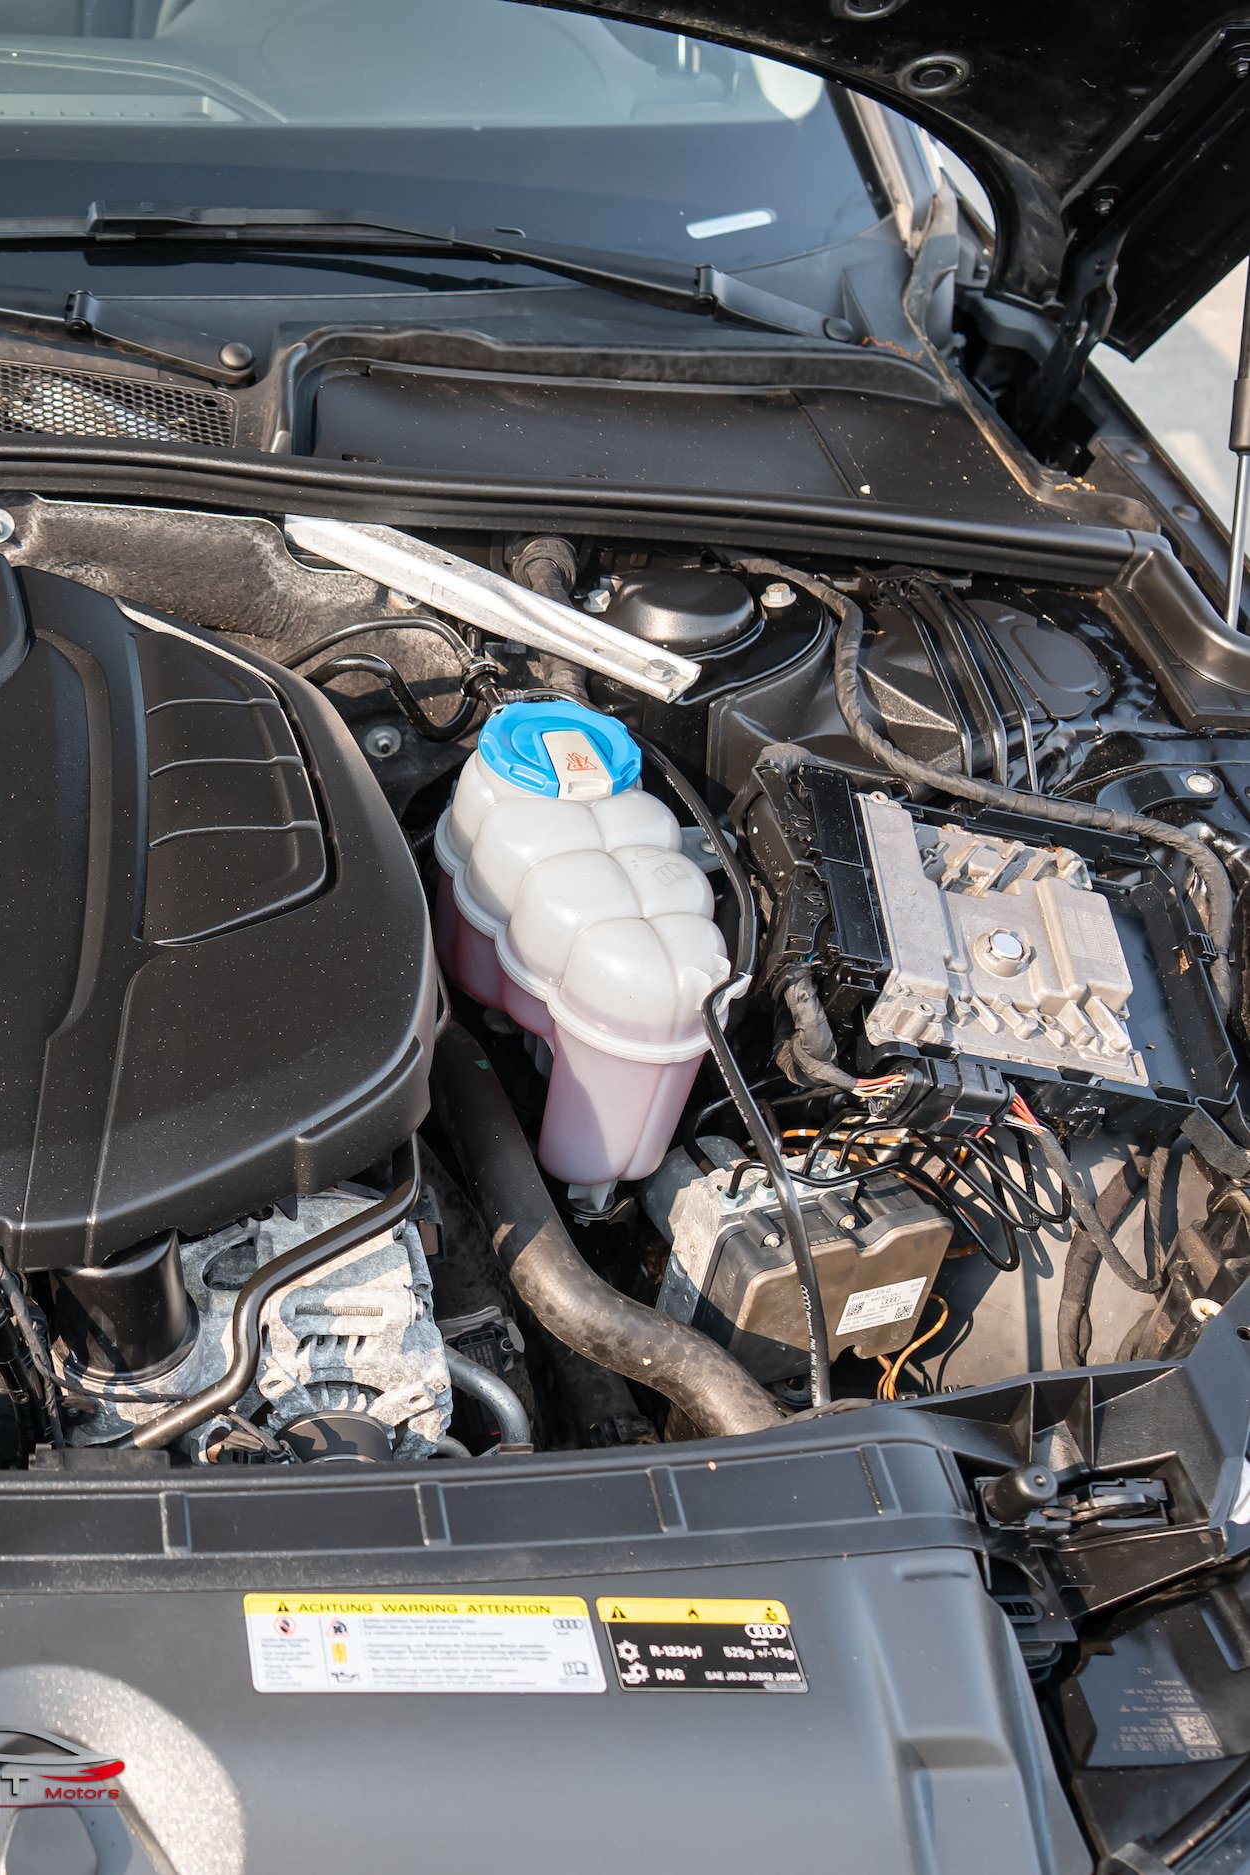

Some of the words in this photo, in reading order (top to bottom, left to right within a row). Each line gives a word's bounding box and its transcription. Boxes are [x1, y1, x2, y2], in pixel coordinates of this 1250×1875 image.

[298, 1602, 374, 1613] ACHTUNG
[382, 1603, 459, 1614] WARNING
[467, 1604, 552, 1614] ATTENTION
[655, 1668, 687, 1682] PAG
